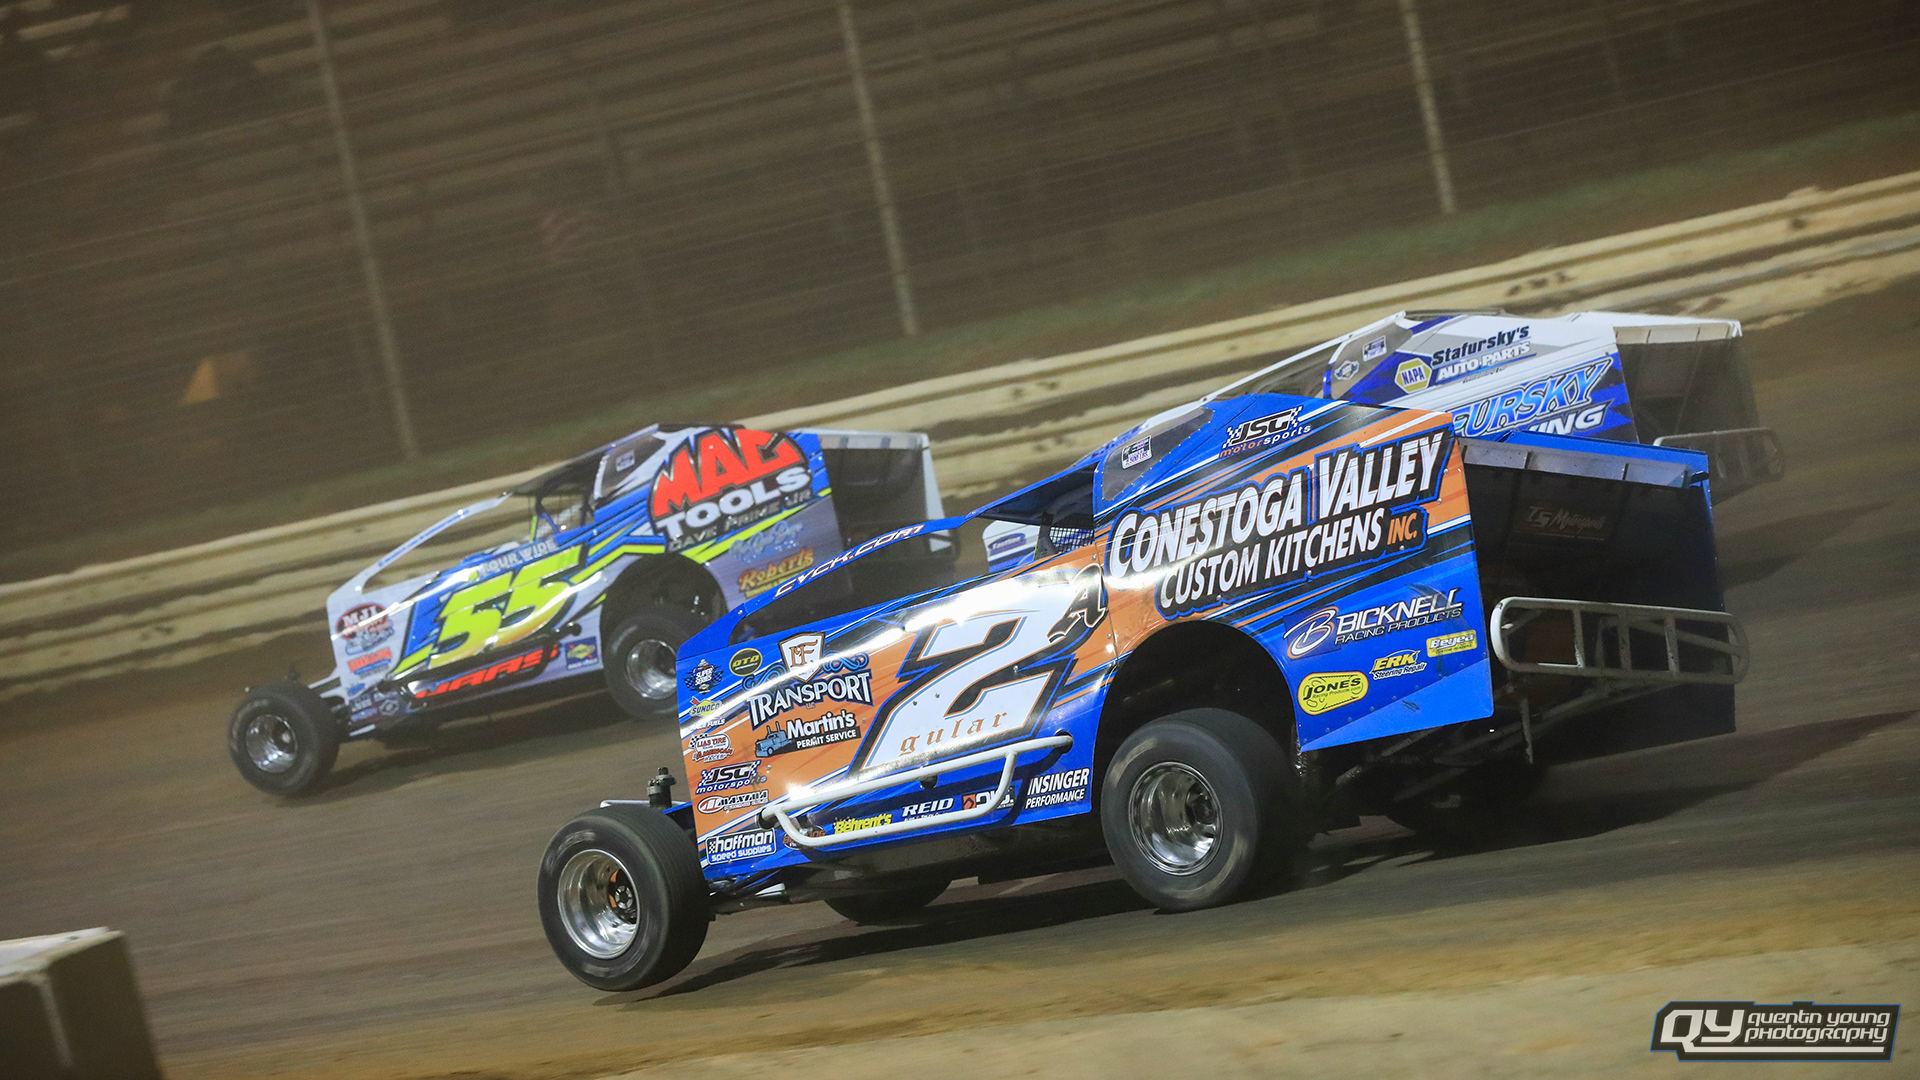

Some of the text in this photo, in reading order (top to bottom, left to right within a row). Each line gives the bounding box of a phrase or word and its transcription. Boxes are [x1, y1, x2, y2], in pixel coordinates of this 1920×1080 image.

[1432, 325, 1530, 367] Stafursky's
[1402, 366, 1425, 385] NAPA
[1437, 358, 1479, 380] AUTO
[1482, 342, 1530, 367] PARTS
[1229, 408, 1294, 446] JSG
[1528, 402, 1607, 435] ING
[1219, 425, 1313, 458] motorsports
[653, 428, 801, 518] MAC
[656, 466, 810, 541] TOOLS
[1110, 432, 1444, 578] CONESTOGA VALLEY
[738, 548, 815, 592] Roberts
[1160, 508, 1418, 609] CUSTOM KITCHENS INC.
[428, 544, 582, 669] 55
[1336, 588, 1463, 635] BICKNELL
[1335, 607, 1462, 645] RACING PRODUCTS
[1430, 634, 1474, 650] Beyea
[862, 576, 1080, 770] 2
[1373, 651, 1418, 671] ERK
[1374, 662, 1427, 680] Steering Repair
[747, 672, 870, 727] TRANSPORT
[1303, 678, 1361, 700] JONES
[692, 702, 720, 715] SUNOCO
[786, 710, 856, 740] Martin's
[796, 729, 857, 749] PERMIT SERVICE
[898, 711, 1008, 756] gular
[712, 737, 727, 745] TIRE
[696, 776, 768, 795] motorsports
[705, 763, 752, 785] JSG
[1028, 767, 1090, 796] INSINGER
[718, 790, 768, 806] MAXIMA
[902, 797, 954, 818] REID
[1025, 788, 1085, 810] PERFORMANCE
[834, 813, 892, 836] Behrent's
[711, 845, 773, 863] speed supplies
[715, 831, 774, 852] hoffman
